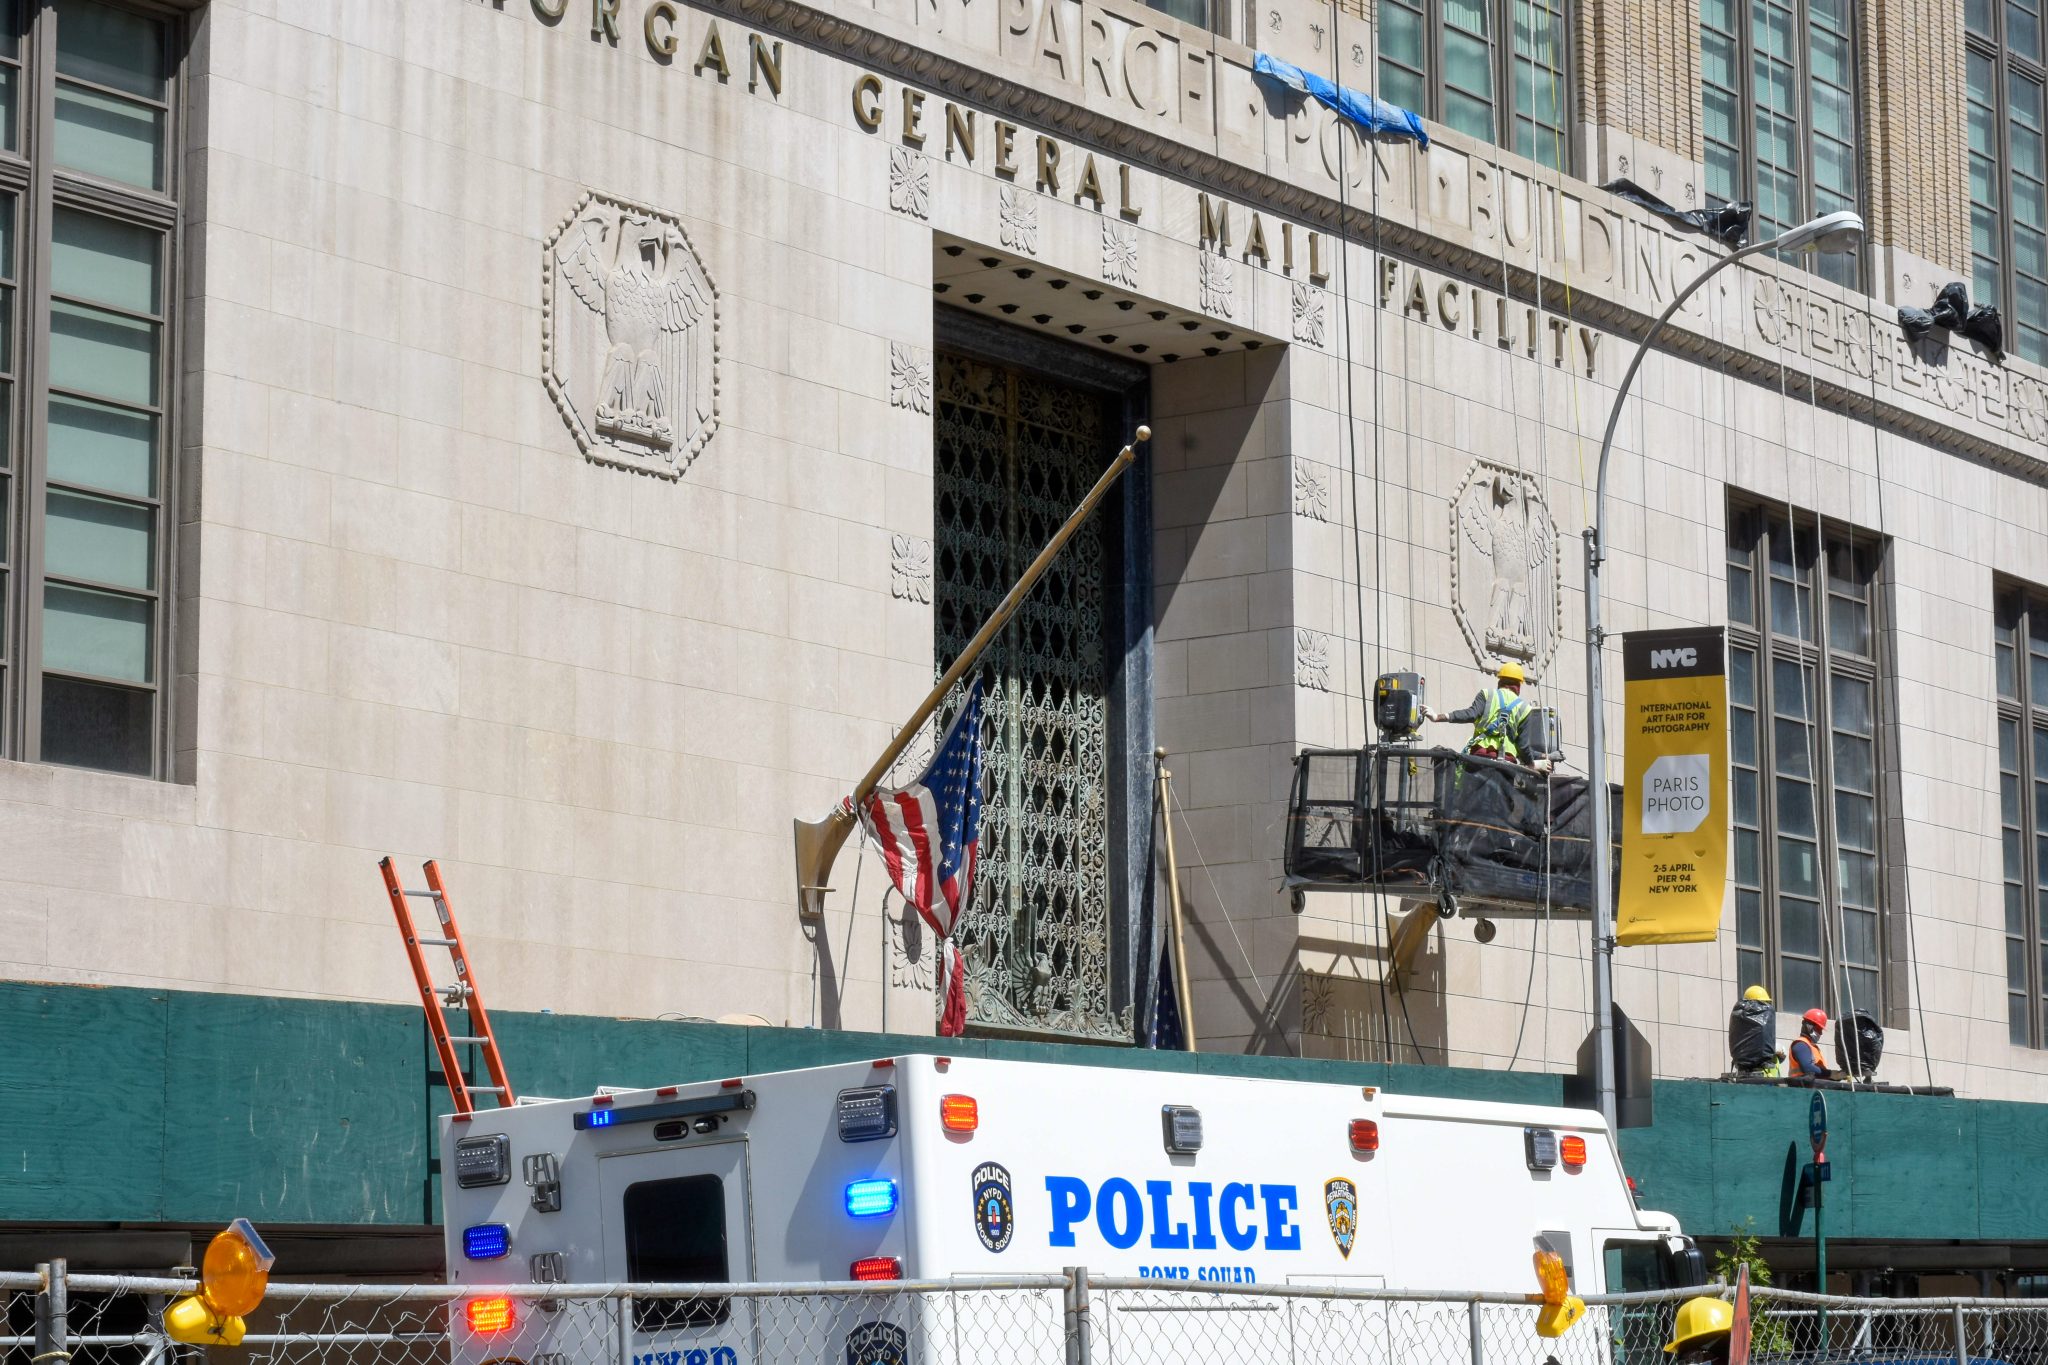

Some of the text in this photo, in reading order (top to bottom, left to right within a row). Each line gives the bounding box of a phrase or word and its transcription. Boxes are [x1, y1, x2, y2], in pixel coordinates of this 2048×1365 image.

[474, 0, 1602, 374] RGAN GENERAL MAIL FACILITY
[1650, 647, 1697, 669] NYC
[1640, 700, 1712, 713] INTERNATIONAL
[1646, 712, 1705, 724] ART FAIR FOR
[1641, 722, 1711, 735] PHOTOGRAPHY
[1653, 776, 1699, 793] PARIS
[1647, 795, 1705, 813] PHOTO
[1653, 863, 1696, 873] 2-5 APRIL
[1656, 873, 1692, 883] PIER 94
[1648, 884, 1698, 894] NEW YORK
[974, 1166, 1010, 1192] POLICE
[1331, 1181, 1350, 1192] POLICE
[983, 1187, 1002, 1201] NYPD
[1045, 1175, 1302, 1251] POLICE
[976, 1222, 1012, 1251] BOMB SQUAD
[850, 1326, 903, 1354] POLICE
[863, 1348, 892, 1363] NYPD
